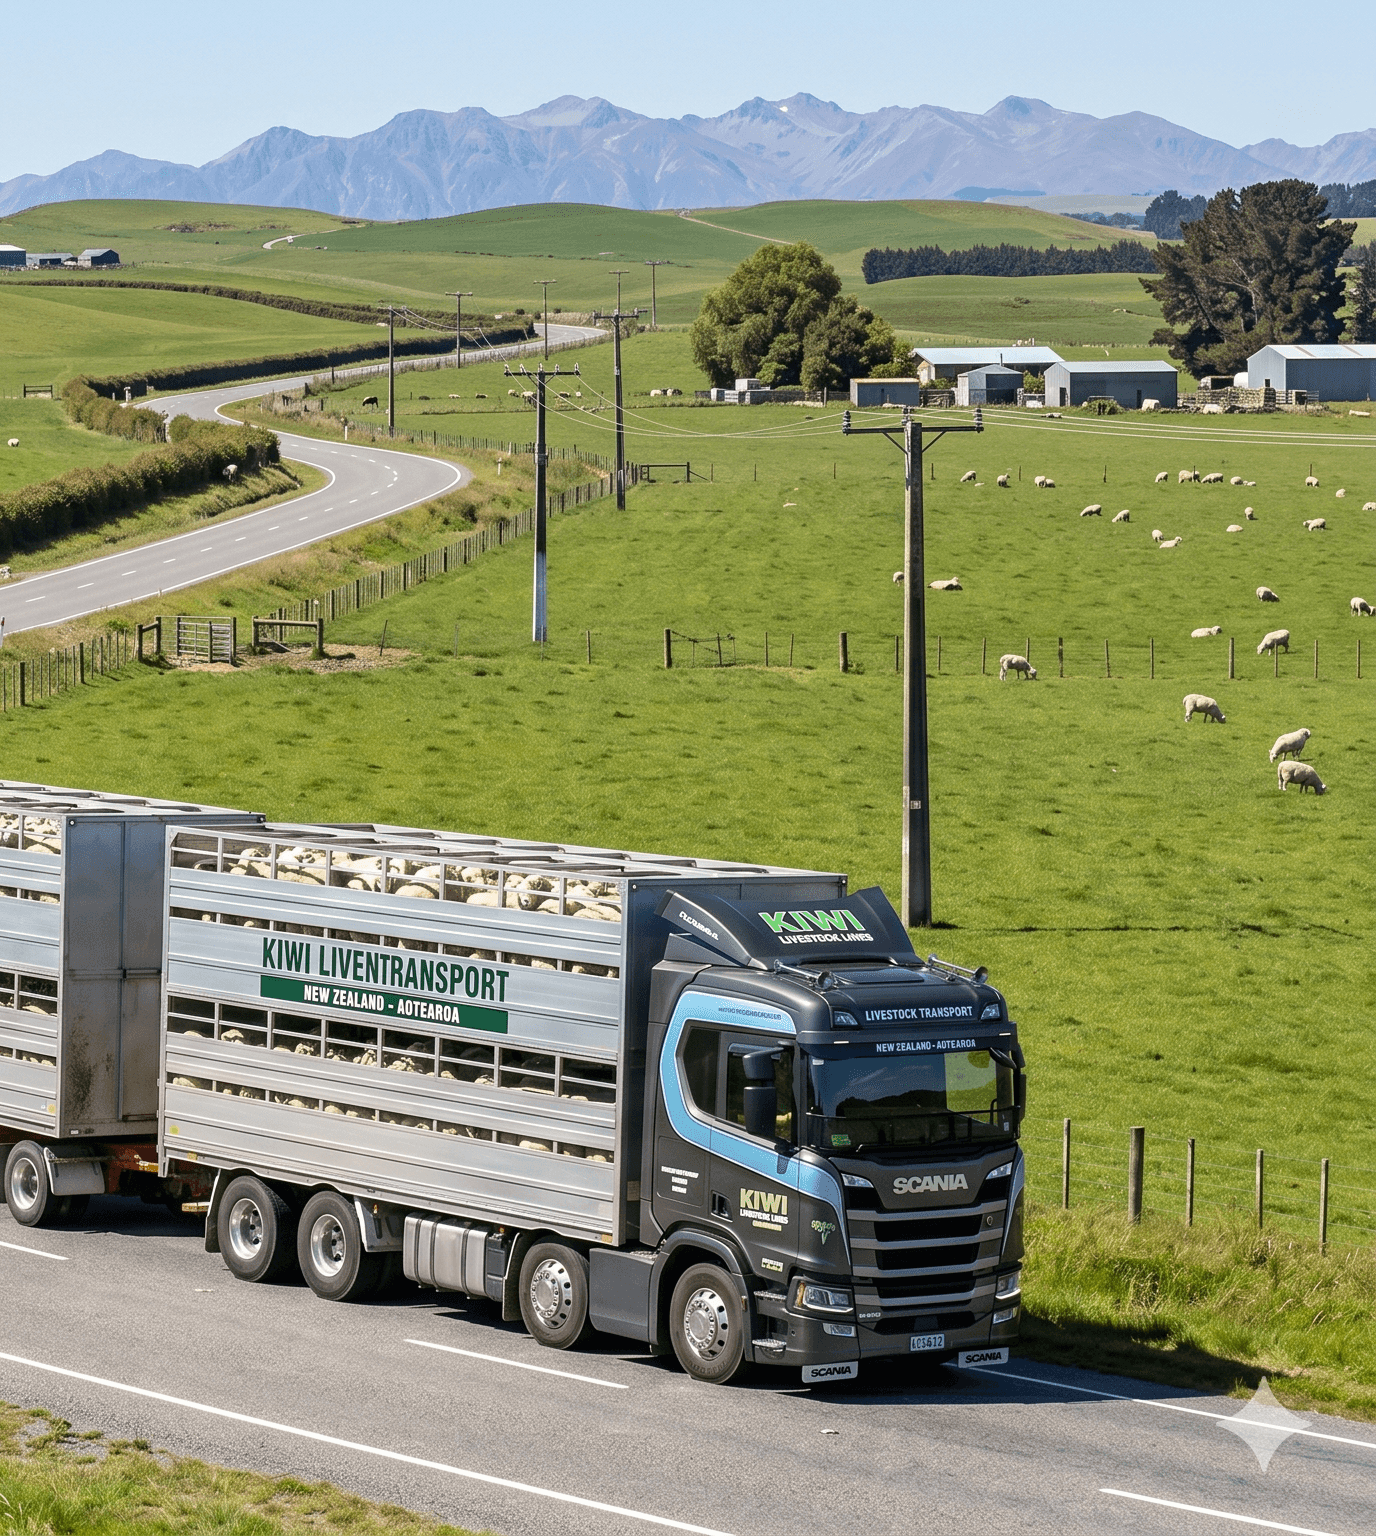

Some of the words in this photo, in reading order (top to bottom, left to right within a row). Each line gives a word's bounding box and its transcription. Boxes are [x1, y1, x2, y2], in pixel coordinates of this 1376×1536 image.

[757, 909, 867, 933] KIWI
[262, 936, 311, 974] KIWI
[319, 944, 510, 1002] LIVENTRANSPORT
[303, 984, 331, 1003] NEW
[332, 988, 385, 1012] ZEALAND
[396, 1000, 461, 1024] AOTEAROA
[865, 1008, 918, 1021] LIVESTOCK
[918, 1006, 973, 1019] TRANSPORT
[876, 1043, 895, 1053] NEW
[892, 1173, 969, 1195] SCANIA
[739, 1187, 788, 1216] KIWI
[964, 1351, 1002, 1364] SCANIA
[810, 1365, 852, 1378] SCANIA
